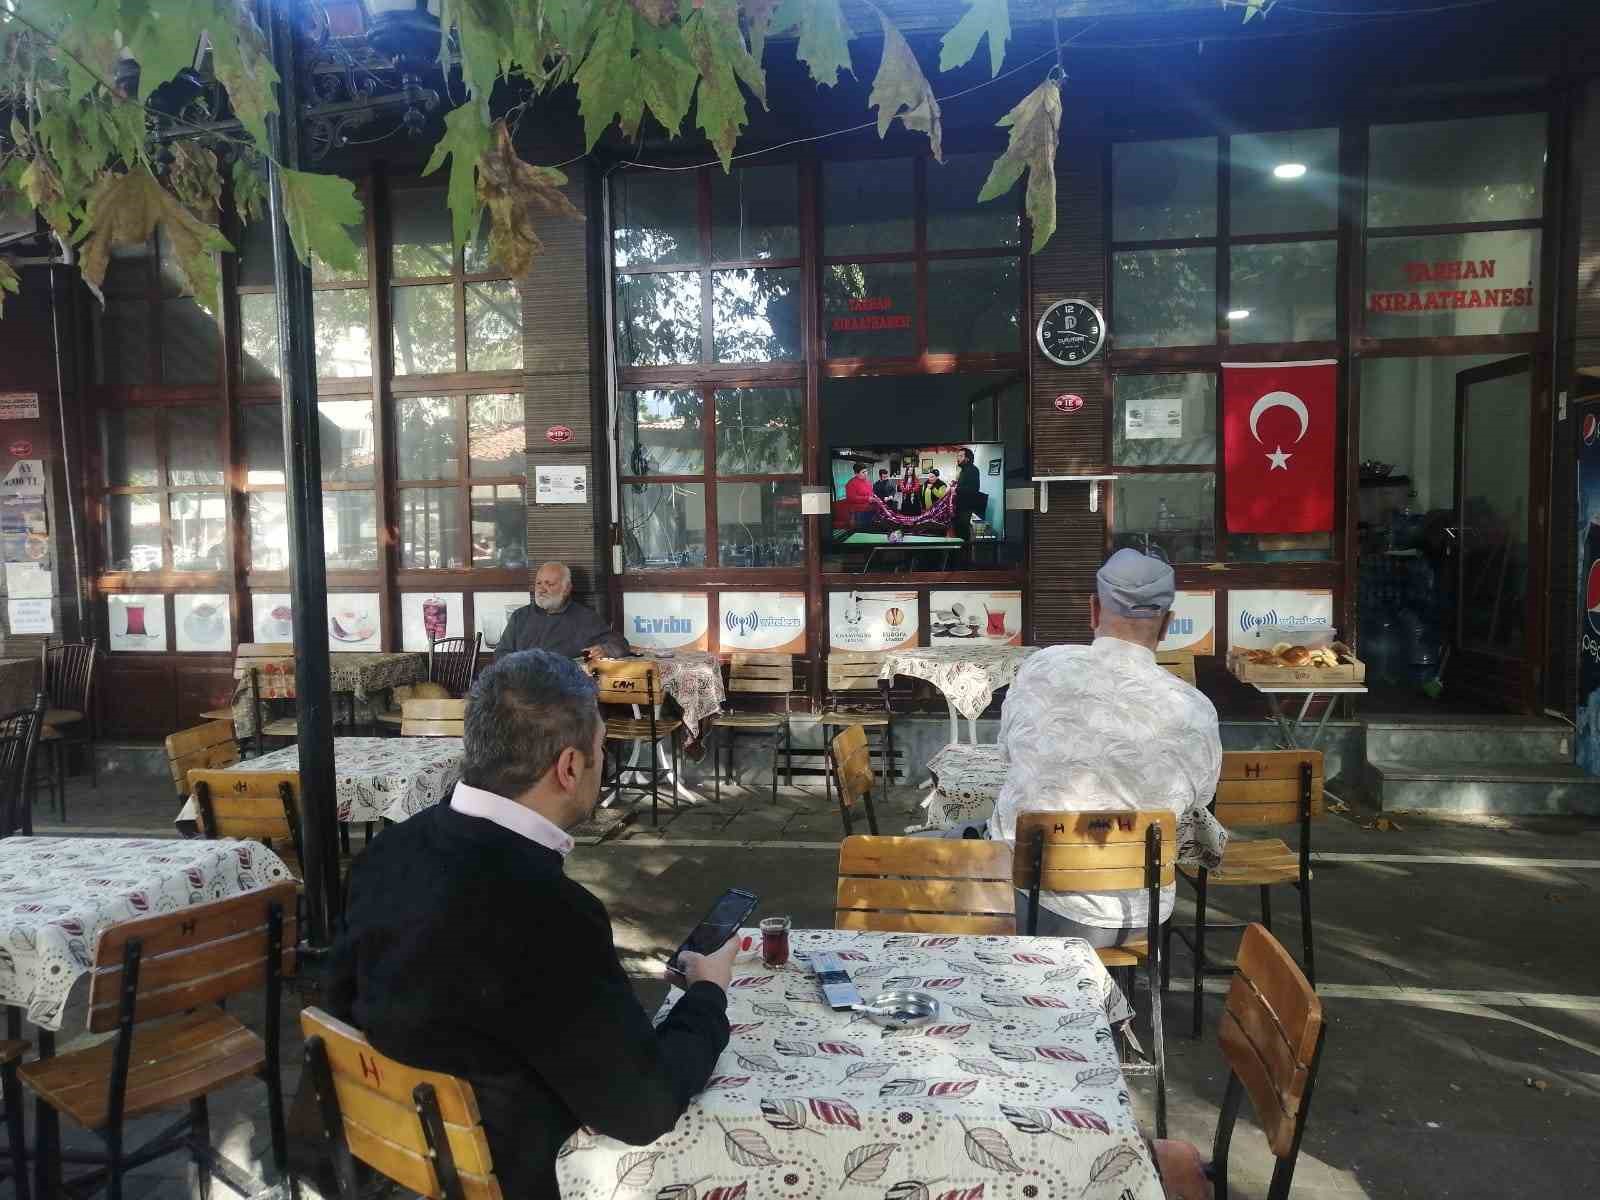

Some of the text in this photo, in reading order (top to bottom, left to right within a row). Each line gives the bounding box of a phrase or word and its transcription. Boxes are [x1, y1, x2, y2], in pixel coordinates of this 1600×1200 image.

[1370, 281, 1533, 311] KIRAATHANESİ
[1065, 305, 1075, 313] 12
[1091, 326, 1099, 334] 3
[1043, 331, 1051, 339] 9
[1069, 352, 1077, 360] 6
[632, 615, 693, 634] tivibu
